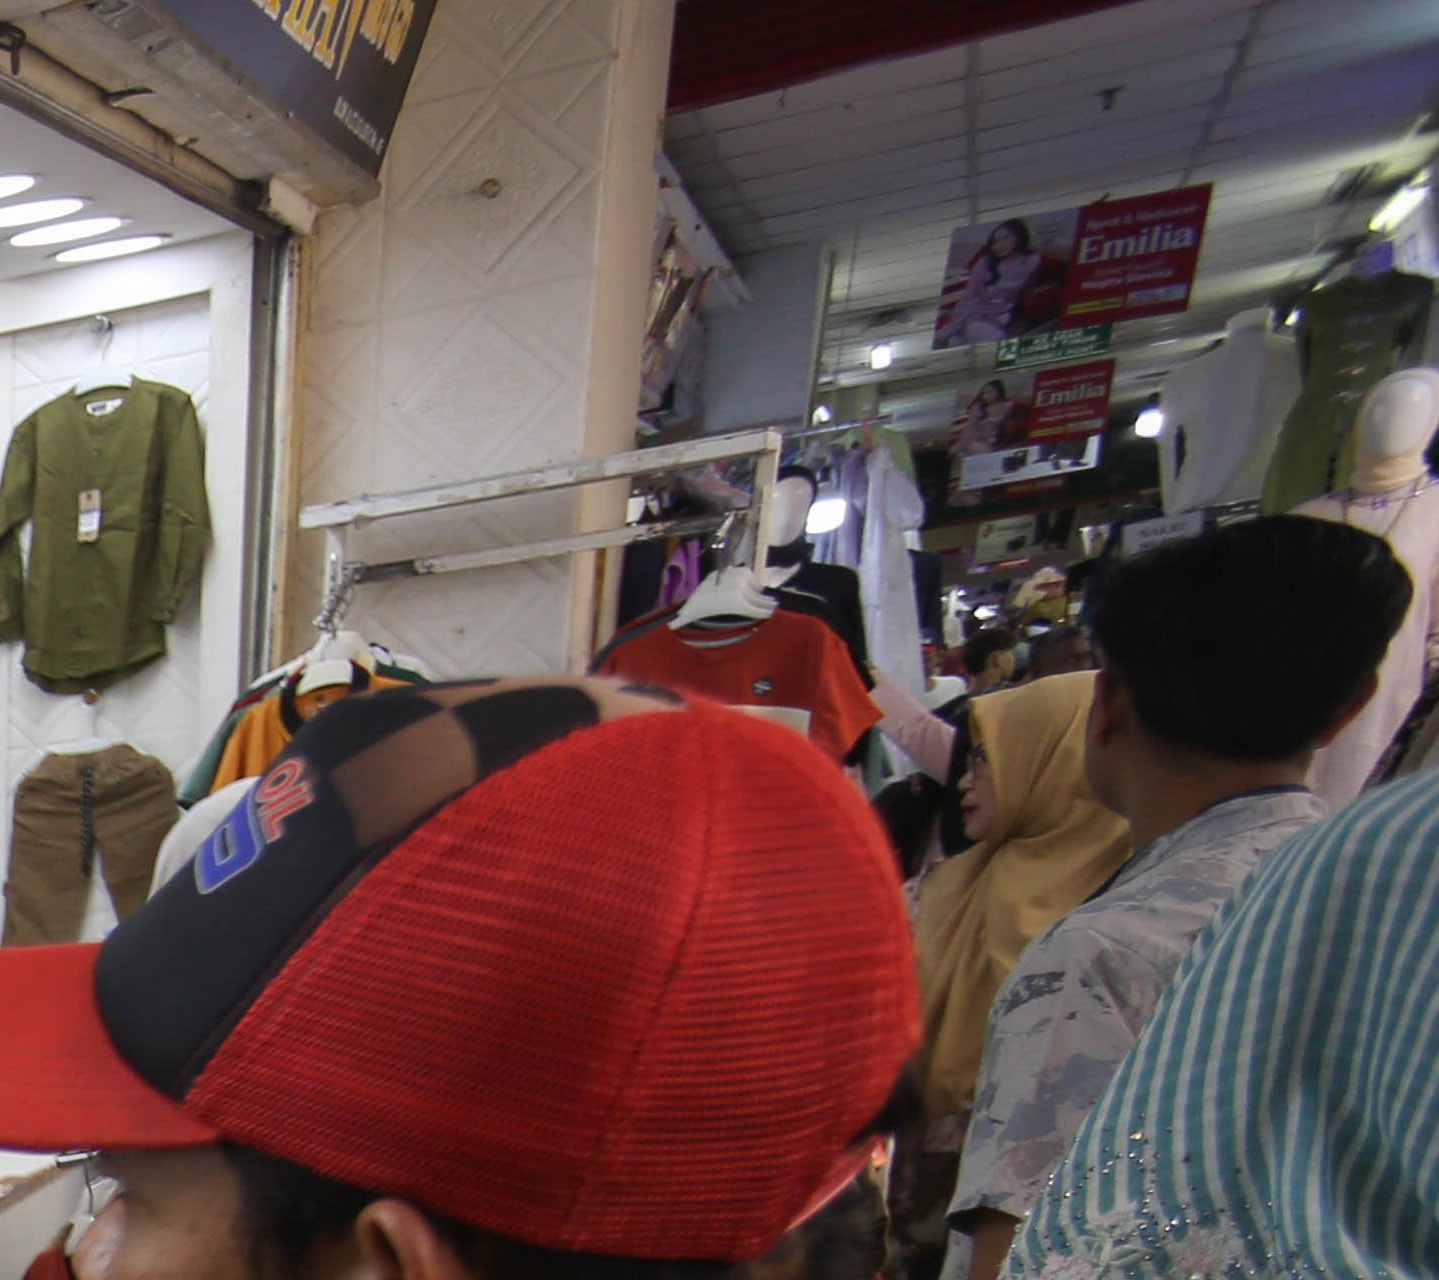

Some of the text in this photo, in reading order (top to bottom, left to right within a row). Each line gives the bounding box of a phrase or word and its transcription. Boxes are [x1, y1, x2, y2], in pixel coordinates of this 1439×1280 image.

[1076, 223, 1194, 265] Emilia
[1034, 383, 1106, 408] Emilia
[255, 756, 315, 844] OIL
